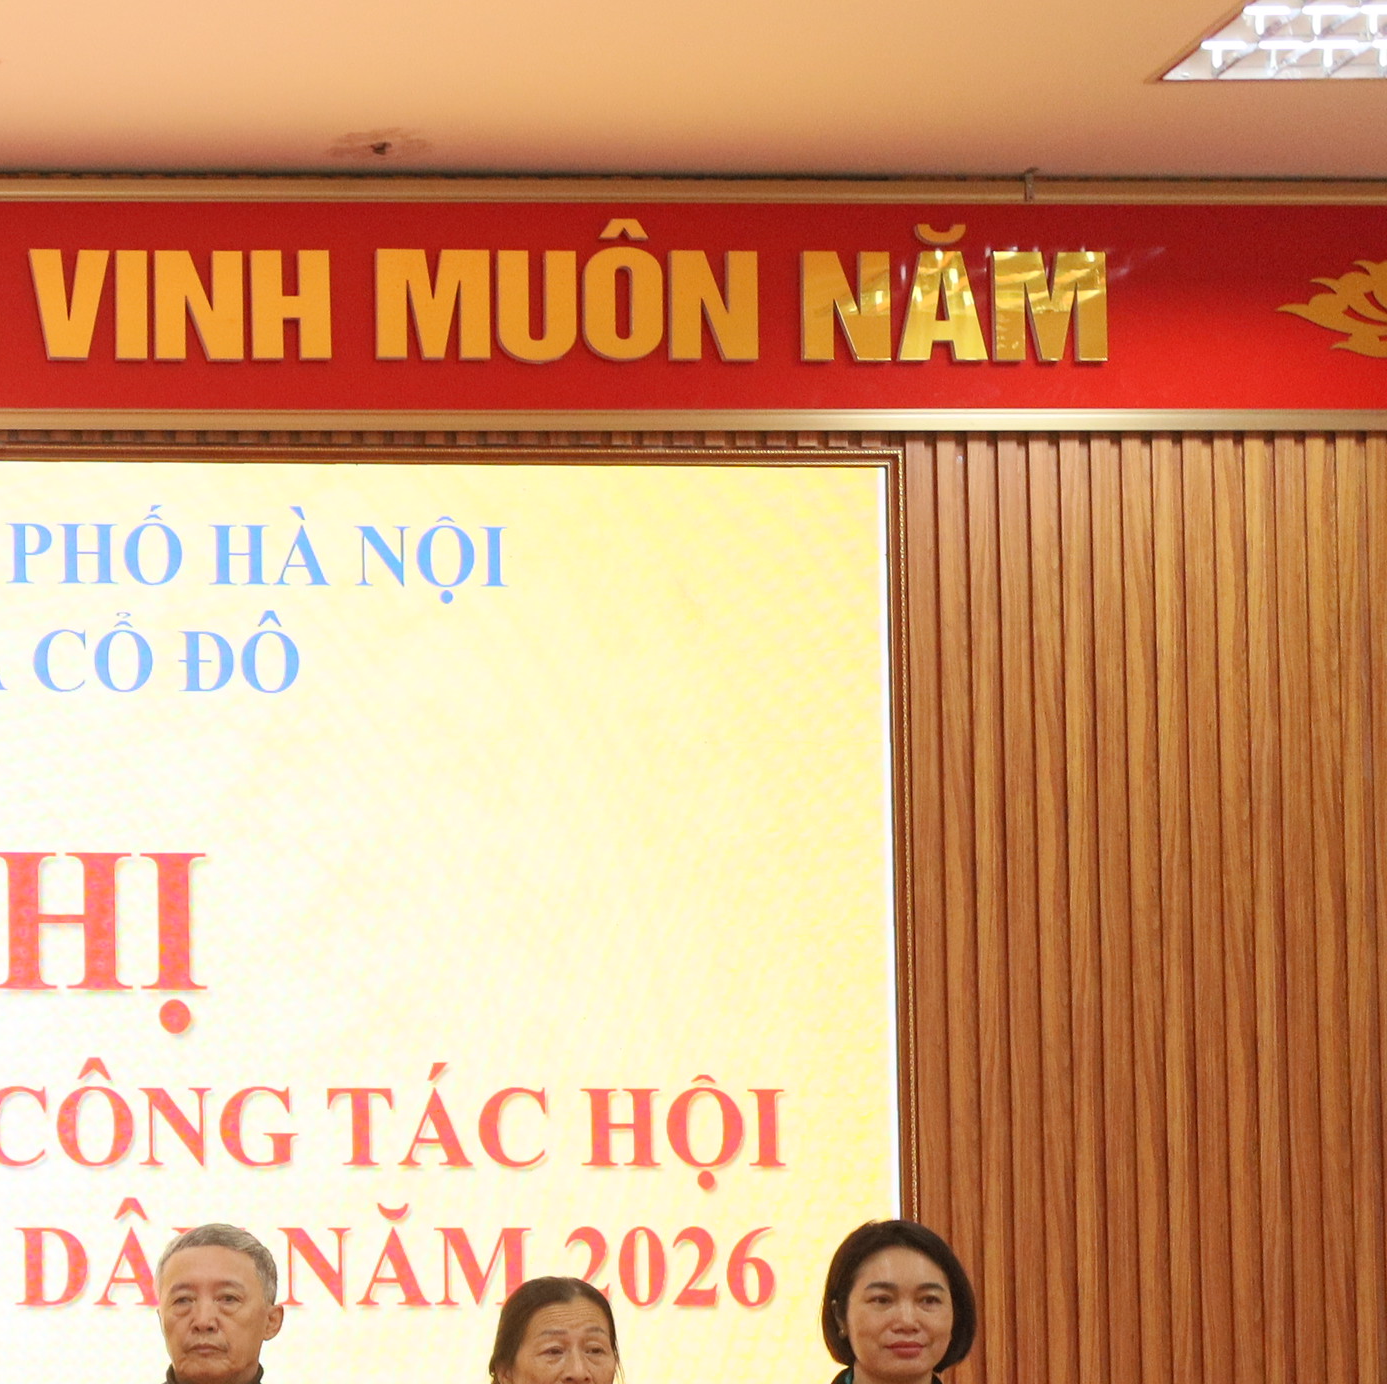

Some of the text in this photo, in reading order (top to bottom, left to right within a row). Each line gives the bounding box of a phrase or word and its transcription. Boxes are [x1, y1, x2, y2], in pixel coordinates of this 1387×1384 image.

[30, 248, 332, 362] VINH
[376, 218, 760, 363] MUÔN
[801, 224, 1109, 363] NĂM
[7, 504, 184, 587] PHỐ
[210, 506, 331, 587] HÀ
[354, 515, 509, 605] NỘI
[33, 611, 155, 694] CỔ
[178, 609, 302, 695] ĐÔ
[326, 1062, 549, 1170] TÁC
[577, 1074, 788, 1191] HỘI
[278, 1202, 532, 1308] NĂM
[564, 1226, 776, 1308] 2026
